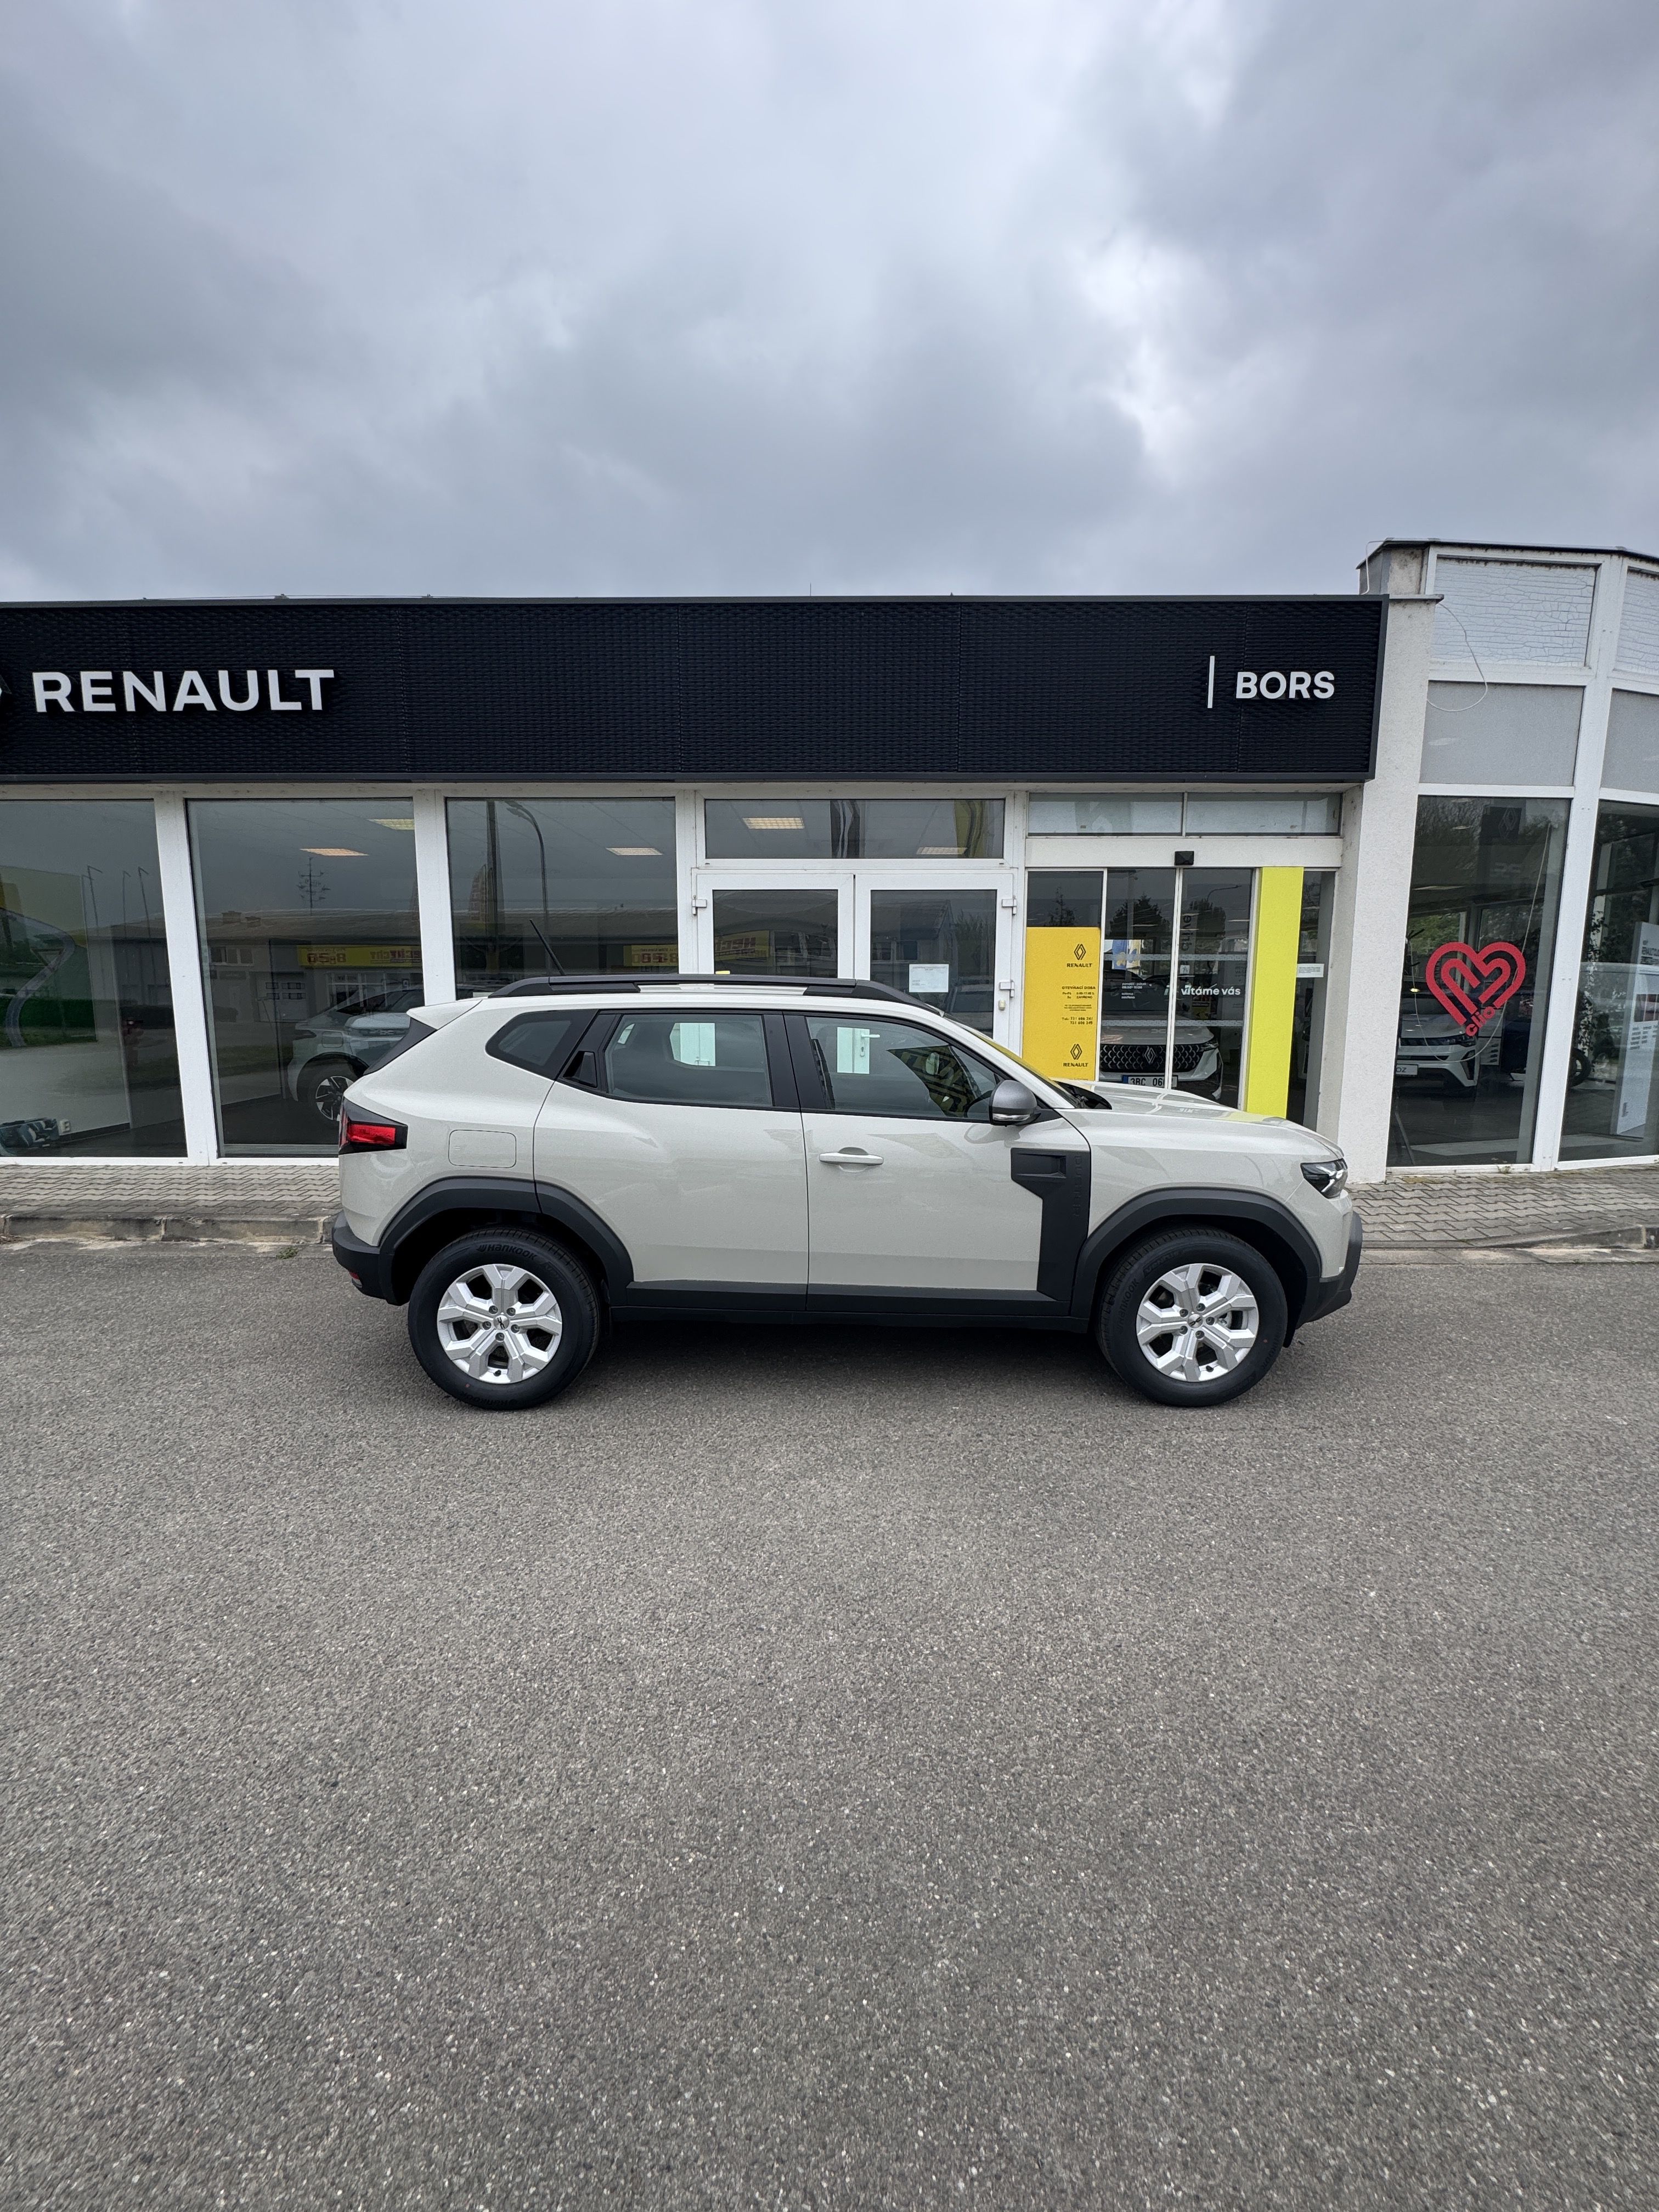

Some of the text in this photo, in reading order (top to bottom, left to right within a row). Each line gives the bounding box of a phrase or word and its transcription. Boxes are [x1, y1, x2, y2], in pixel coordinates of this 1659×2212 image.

[32, 669, 335, 713] RENAULT
[1235, 671, 1335, 699] BORS
[1221, 986, 1241, 996] vás
[1465, 1006, 1496, 1036] clio
